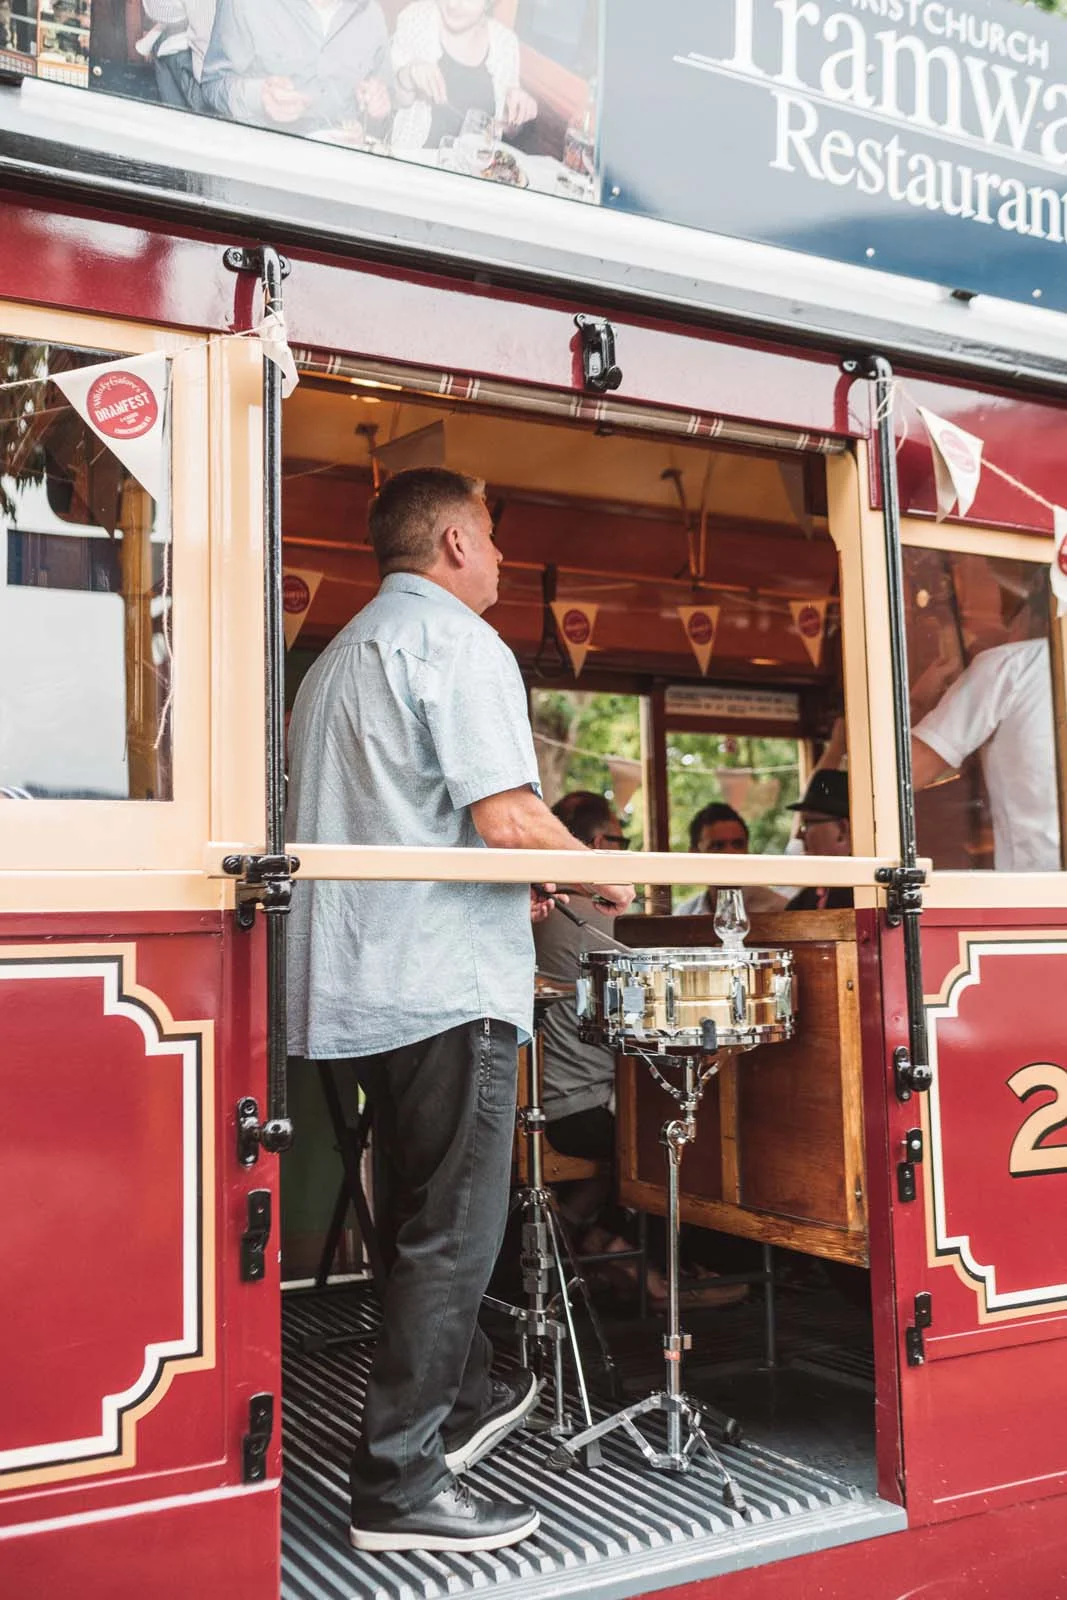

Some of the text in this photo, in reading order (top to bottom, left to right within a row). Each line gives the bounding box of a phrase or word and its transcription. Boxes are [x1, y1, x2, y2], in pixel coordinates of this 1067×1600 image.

[848, 0, 1048, 69] ISTCHURCH
[94, 391, 150, 423] DRAMFEST
[1005, 1062, 1067, 1178] 2
